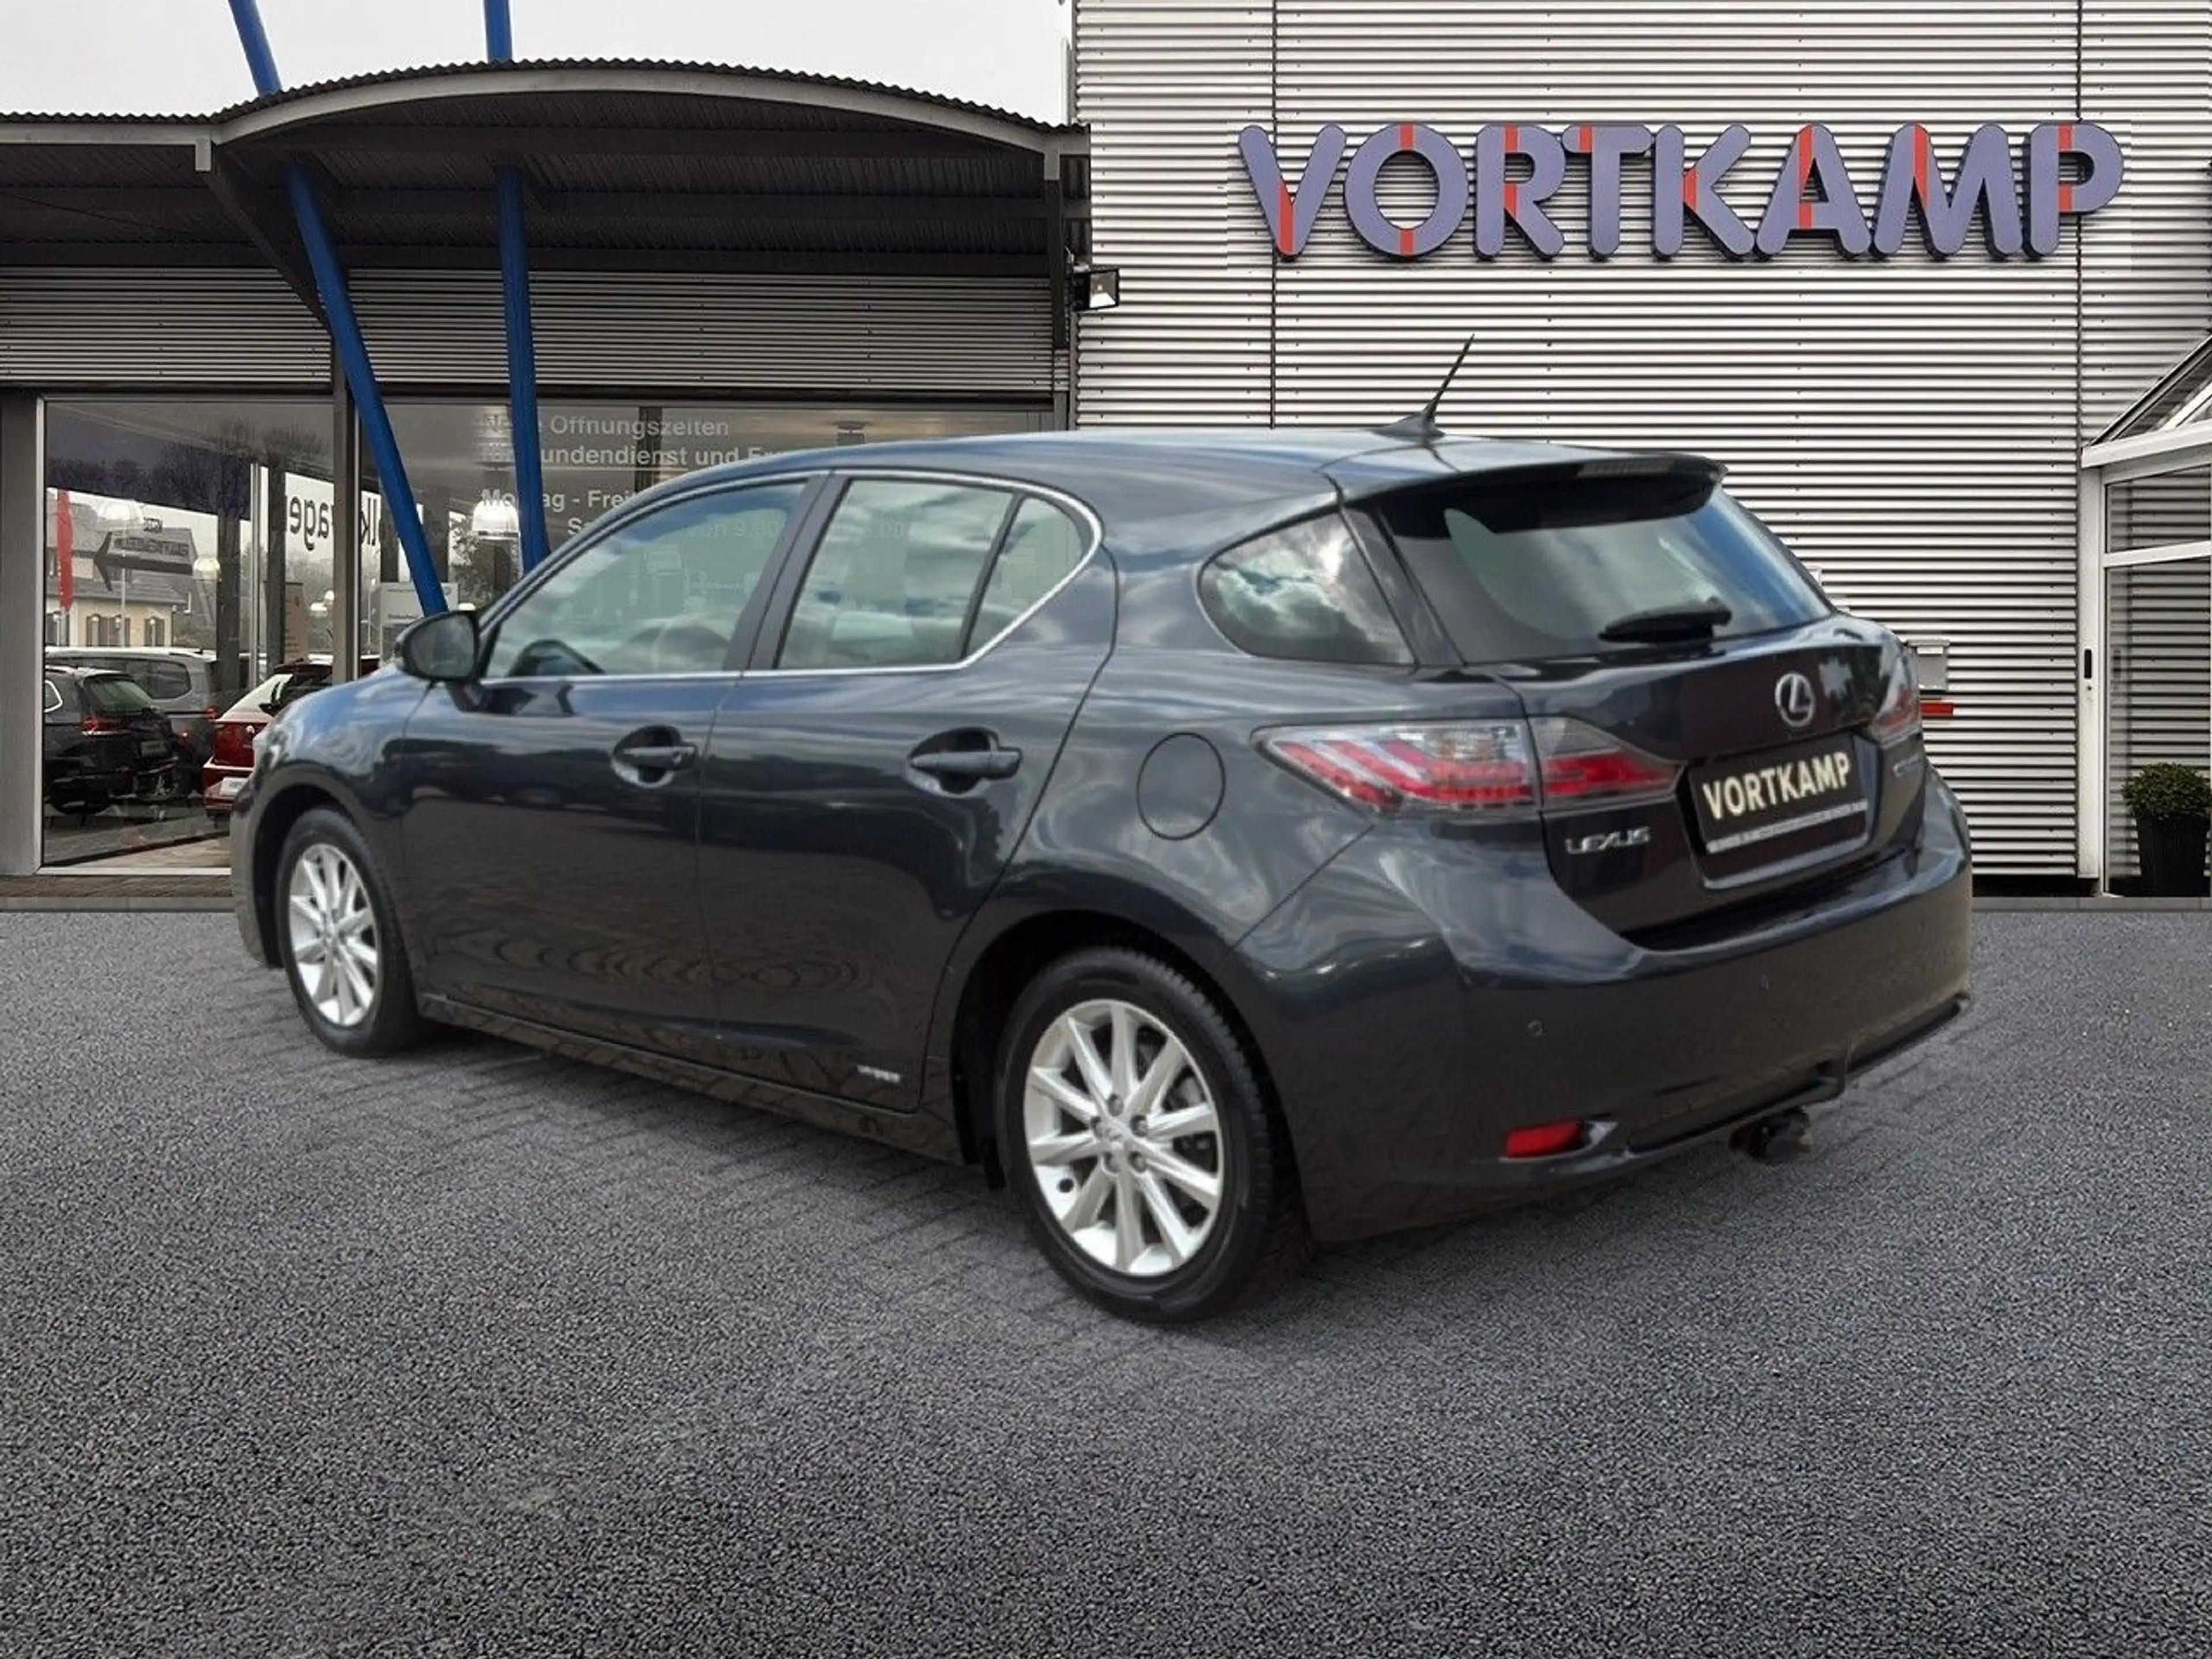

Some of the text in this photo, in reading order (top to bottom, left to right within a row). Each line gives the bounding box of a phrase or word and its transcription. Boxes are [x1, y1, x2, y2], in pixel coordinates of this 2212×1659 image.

[1238, 123, 2124, 256] VORTKAMP
[541, 446, 688, 465] undendienst
[695, 448, 738, 465] und
[1702, 751, 1851, 820] VORTKAMP
[1565, 826, 1650, 854] LEXUS
